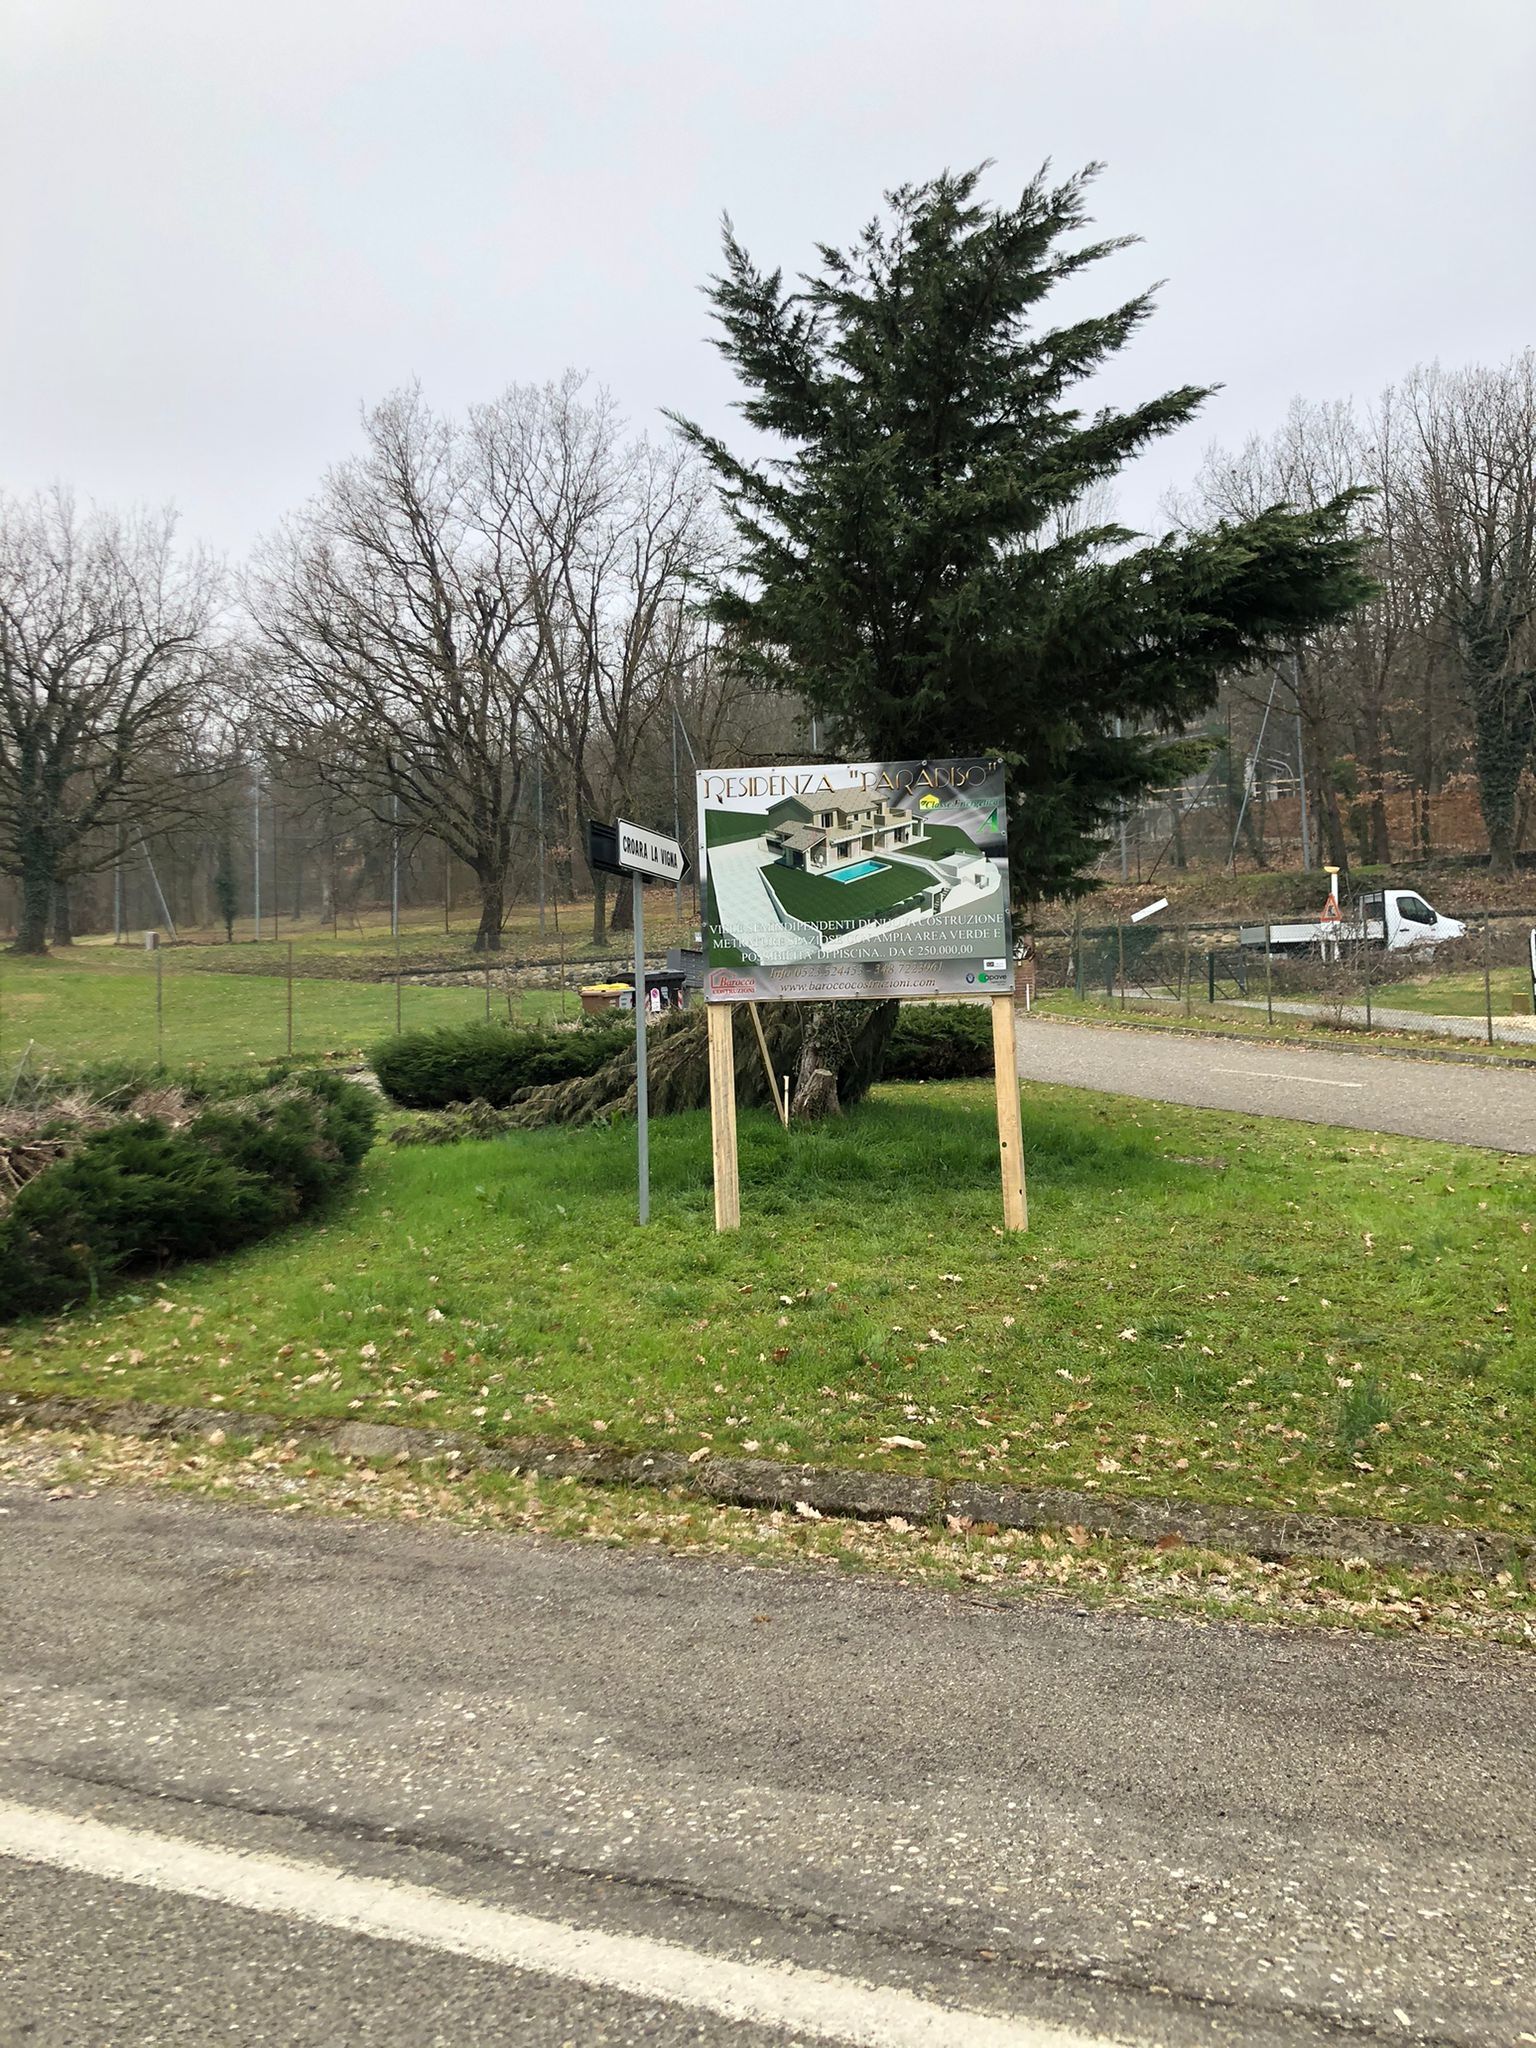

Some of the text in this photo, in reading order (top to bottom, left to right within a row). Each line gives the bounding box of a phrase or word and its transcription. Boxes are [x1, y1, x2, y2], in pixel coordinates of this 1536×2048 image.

[704, 762, 997, 804] RESIDENZA "PARADISO"
[623, 836, 678, 869] CROARA LA VIGNA
[858, 918, 872, 929] DI
[918, 913, 1004, 927] COSTRUZIONE
[874, 931, 912, 943] AMPIA
[914, 929, 947, 942] AREA
[950, 928, 990, 940] VERDE
[994, 928, 1001, 938] E
[817, 949, 831, 960] DI
[889, 946, 906, 957] DA
[908, 946, 915, 956] €
[918, 944, 973, 956] 250.000,00
[720, 976, 755, 986] Barocco
[770, 967, 791, 981] Info
[780, 978, 936, 992] www.baroccocostruzioni.com
